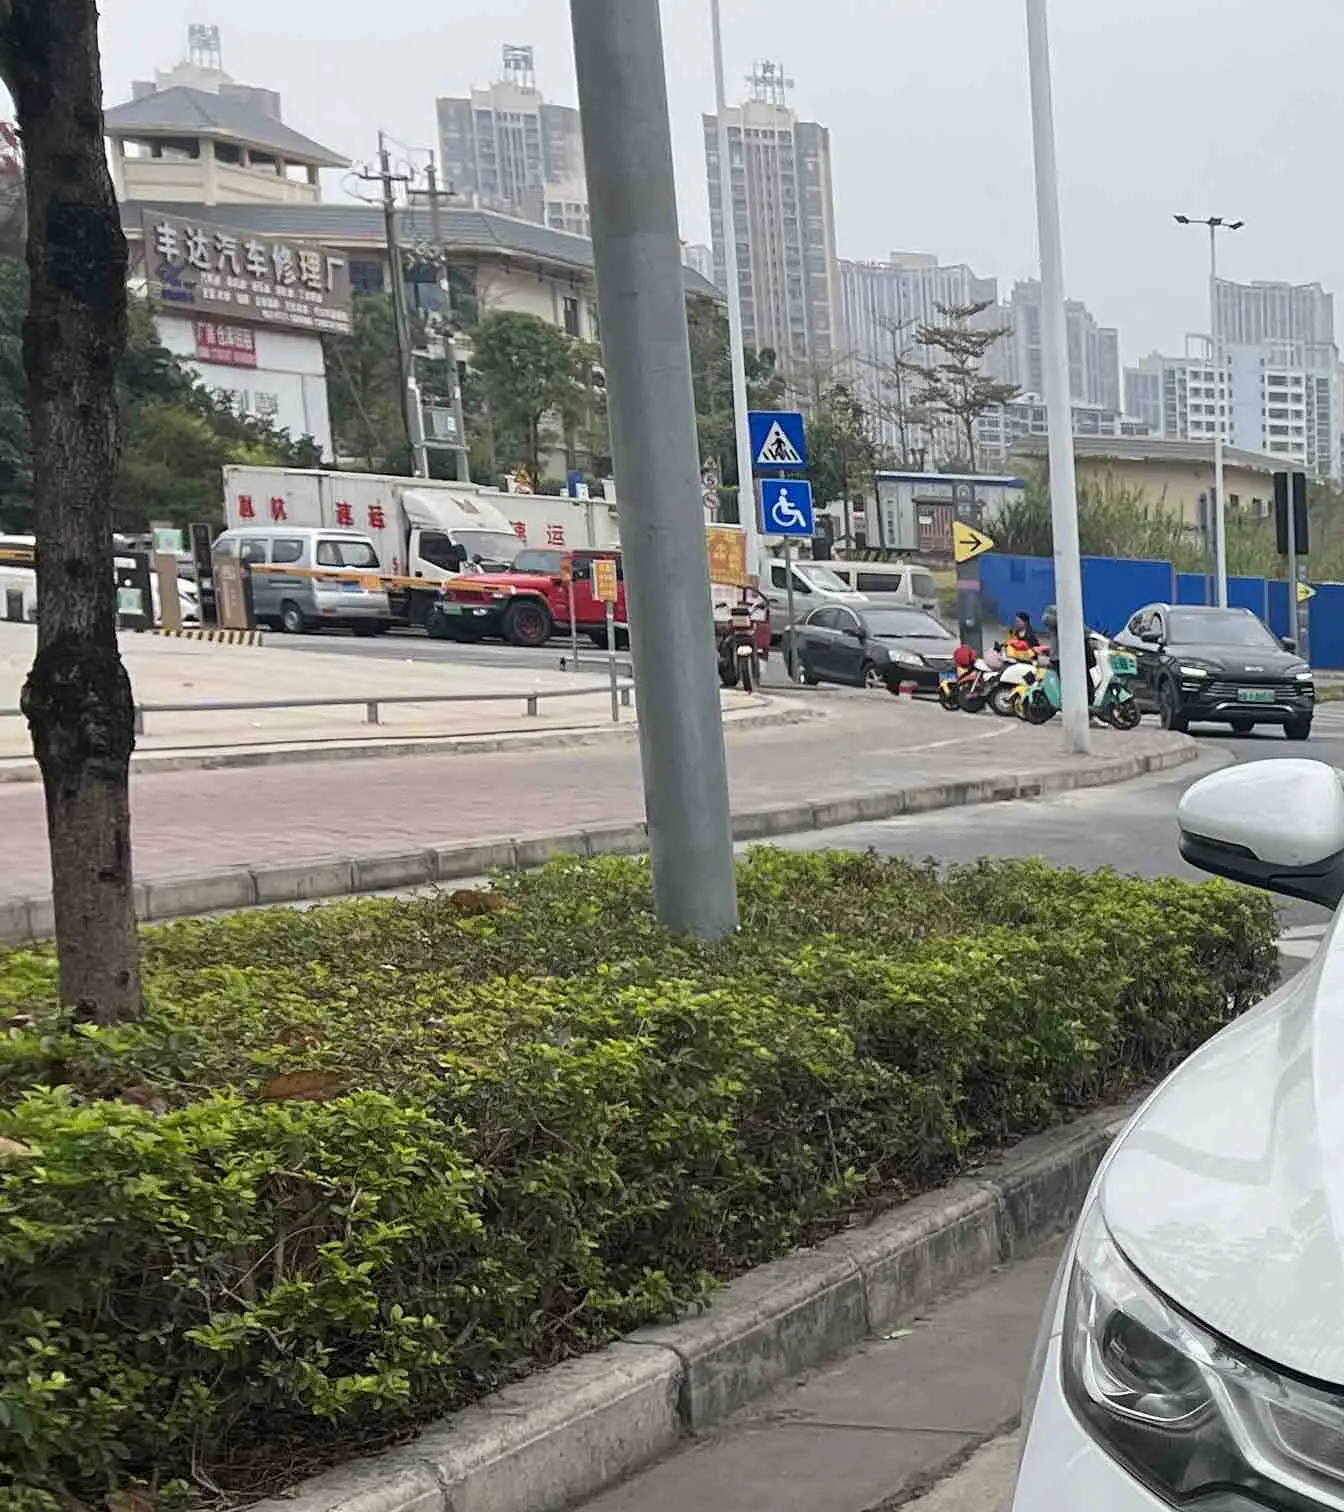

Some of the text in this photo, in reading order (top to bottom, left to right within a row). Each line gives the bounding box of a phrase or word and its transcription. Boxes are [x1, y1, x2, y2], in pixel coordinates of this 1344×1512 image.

[155, 219, 345, 292] 丰达汽车修理厂
